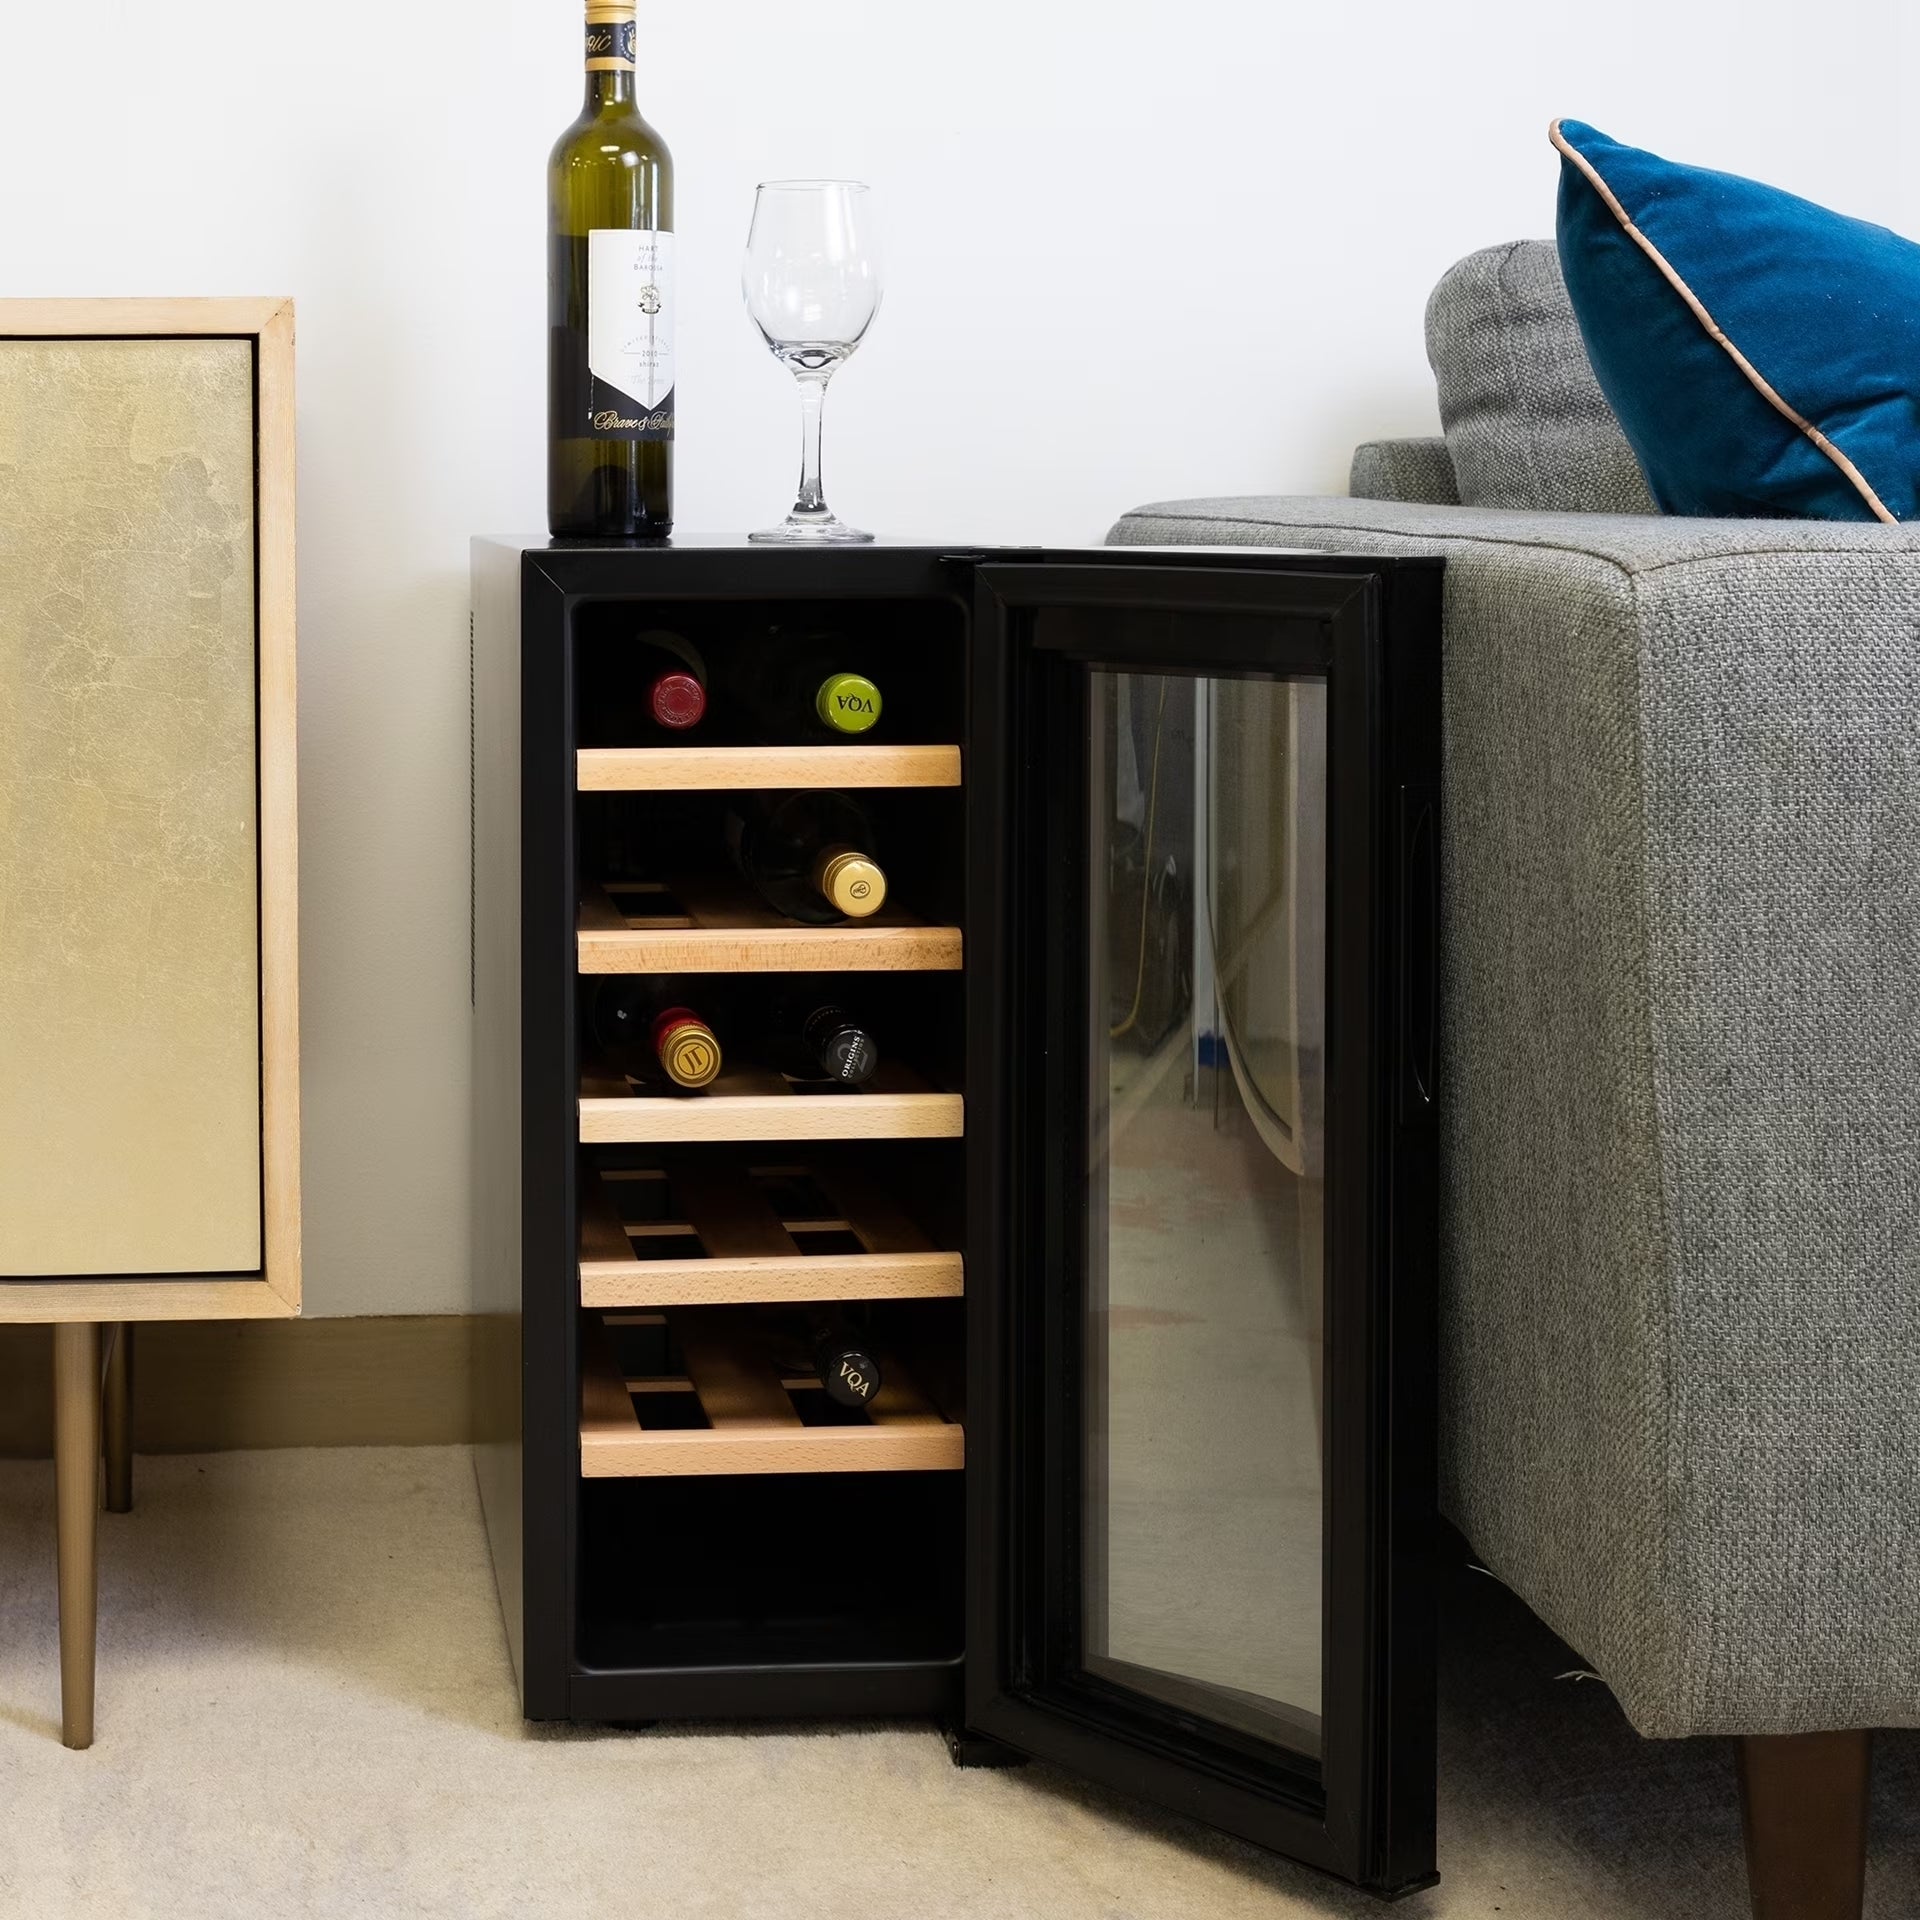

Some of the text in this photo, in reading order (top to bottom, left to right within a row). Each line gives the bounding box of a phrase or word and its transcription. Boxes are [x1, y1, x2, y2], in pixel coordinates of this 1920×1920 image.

[594, 410, 638, 430] Brave
[836, 693, 875, 714] VQA
[842, 1035, 861, 1077] ORIGINS
[840, 1361, 870, 1398] VQA
